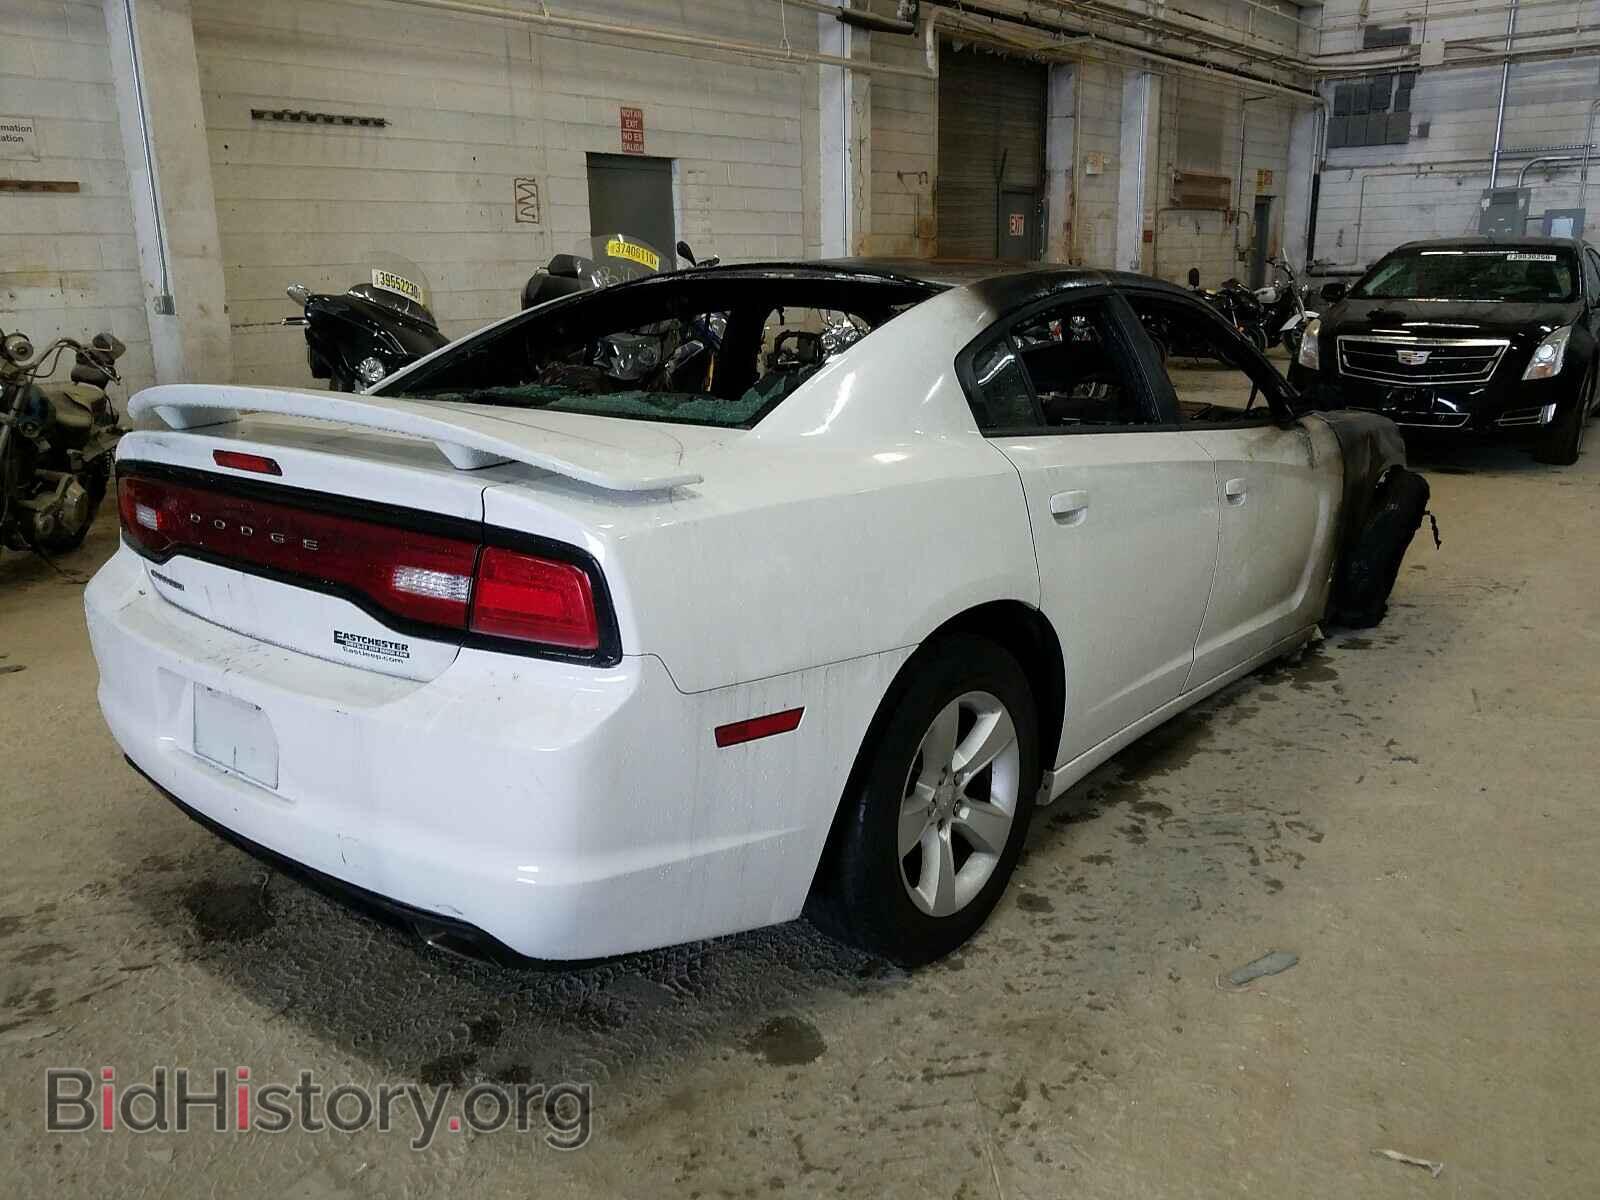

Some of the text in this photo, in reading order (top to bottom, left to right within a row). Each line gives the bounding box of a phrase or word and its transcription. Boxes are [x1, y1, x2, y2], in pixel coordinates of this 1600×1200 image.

[625, 119, 639, 129] EXIT
[623, 131, 633, 141] NO
[623, 143, 644, 152] SALIDA
[1010, 215, 1024, 234] EXIT
[190, 513, 319, 551] DODGE
[333, 630, 409, 652] EASTCHESTER
